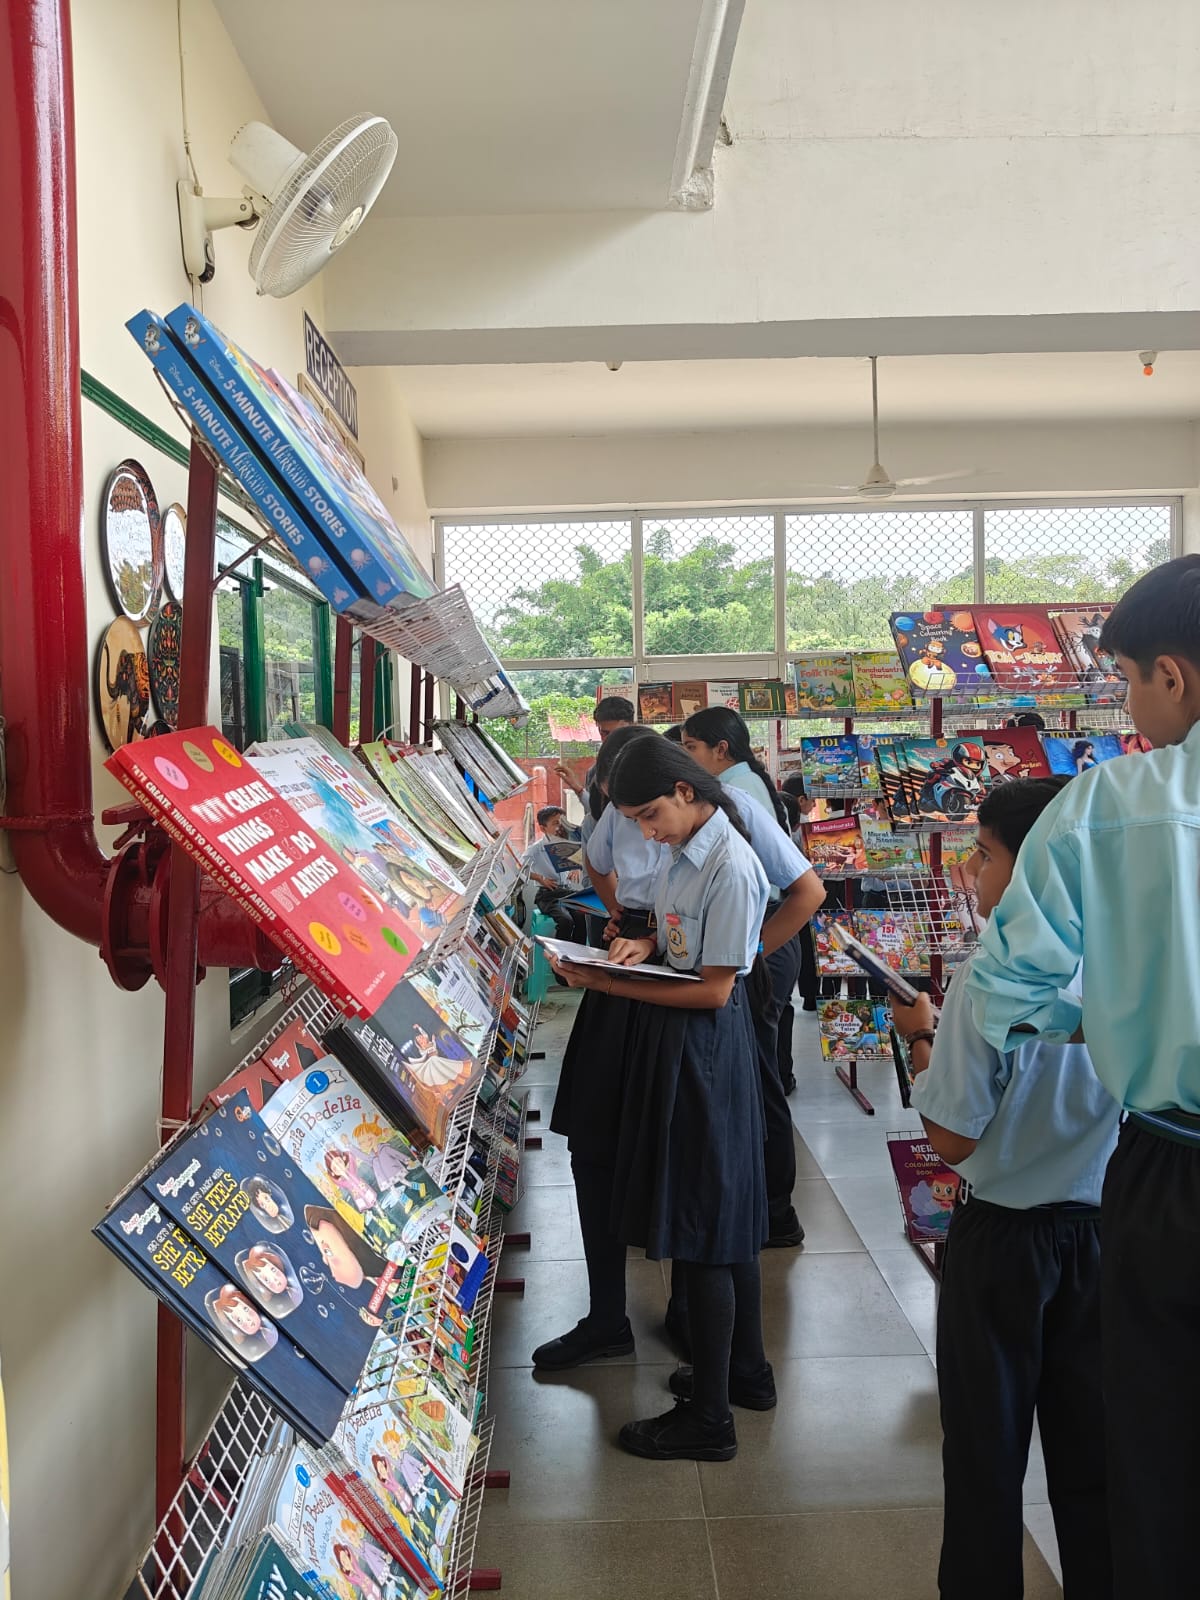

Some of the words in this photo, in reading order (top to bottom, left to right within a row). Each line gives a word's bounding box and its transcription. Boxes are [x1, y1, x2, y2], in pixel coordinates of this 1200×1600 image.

[168, 362, 184, 388] Disney
[209, 355, 225, 380] Disney
[306, 319, 357, 434] RECEPTION
[182, 386, 233, 449] 5-MINUTE
[263, 493, 304, 545] STORIES
[223, 379, 275, 442] 5-MINUTE
[304, 486, 348, 538] STORIES
[920, 623, 942, 631] Space
[800, 669, 821, 678] Folk
[823, 668, 848, 677] Tales
[815, 659, 832, 667] 101
[984, 650, 1016, 664] TOM
[1023, 651, 1064, 664] JERRY
[820, 738, 839, 747] 101
[875, 736, 894, 745] 101
[224, 780, 275, 814] CREATE
[145, 781, 171, 811] CREATE
[170, 810, 197, 836] THINGS
[194, 833, 206, 846] TO
[203, 842, 226, 866] MAKE
[229, 871, 242, 883] DO
[240, 880, 252, 893] BY
[250, 890, 277, 921] ARTISTS
[217, 815, 275, 856] THINGS
[134, 789, 159, 819] CREATE
[159, 816, 185, 842] THINGS
[182, 839, 194, 851] TO
[192, 849, 215, 874] MAKE
[217, 875, 229, 888] DO
[227, 886, 239, 898] BY
[237, 896, 263, 923] ARTISTS
[244, 844, 294, 885] MAKE
[289, 830, 317, 855] DO
[290, 855, 339, 899] ARTISTS
[882, 925, 896, 933] 151
[283, 929, 301, 947] Edited
[306, 952, 320, 968] Sally
[840, 1014, 855, 1022] 151
[312, 1077, 322, 1088] 1
[277, 1119, 289, 1133] Can
[286, 1092, 309, 1119] Read!
[300, 1094, 362, 1131] Bedelia
[187, 1203, 213, 1231] SHE
[205, 1173, 238, 1212] FEELS
[204, 1190, 250, 1248] BETRAYED
[153, 1240, 181, 1271] SHE
[377, 1280, 388, 1295] GAME
[305, 1490, 335, 1522] Bedelia
